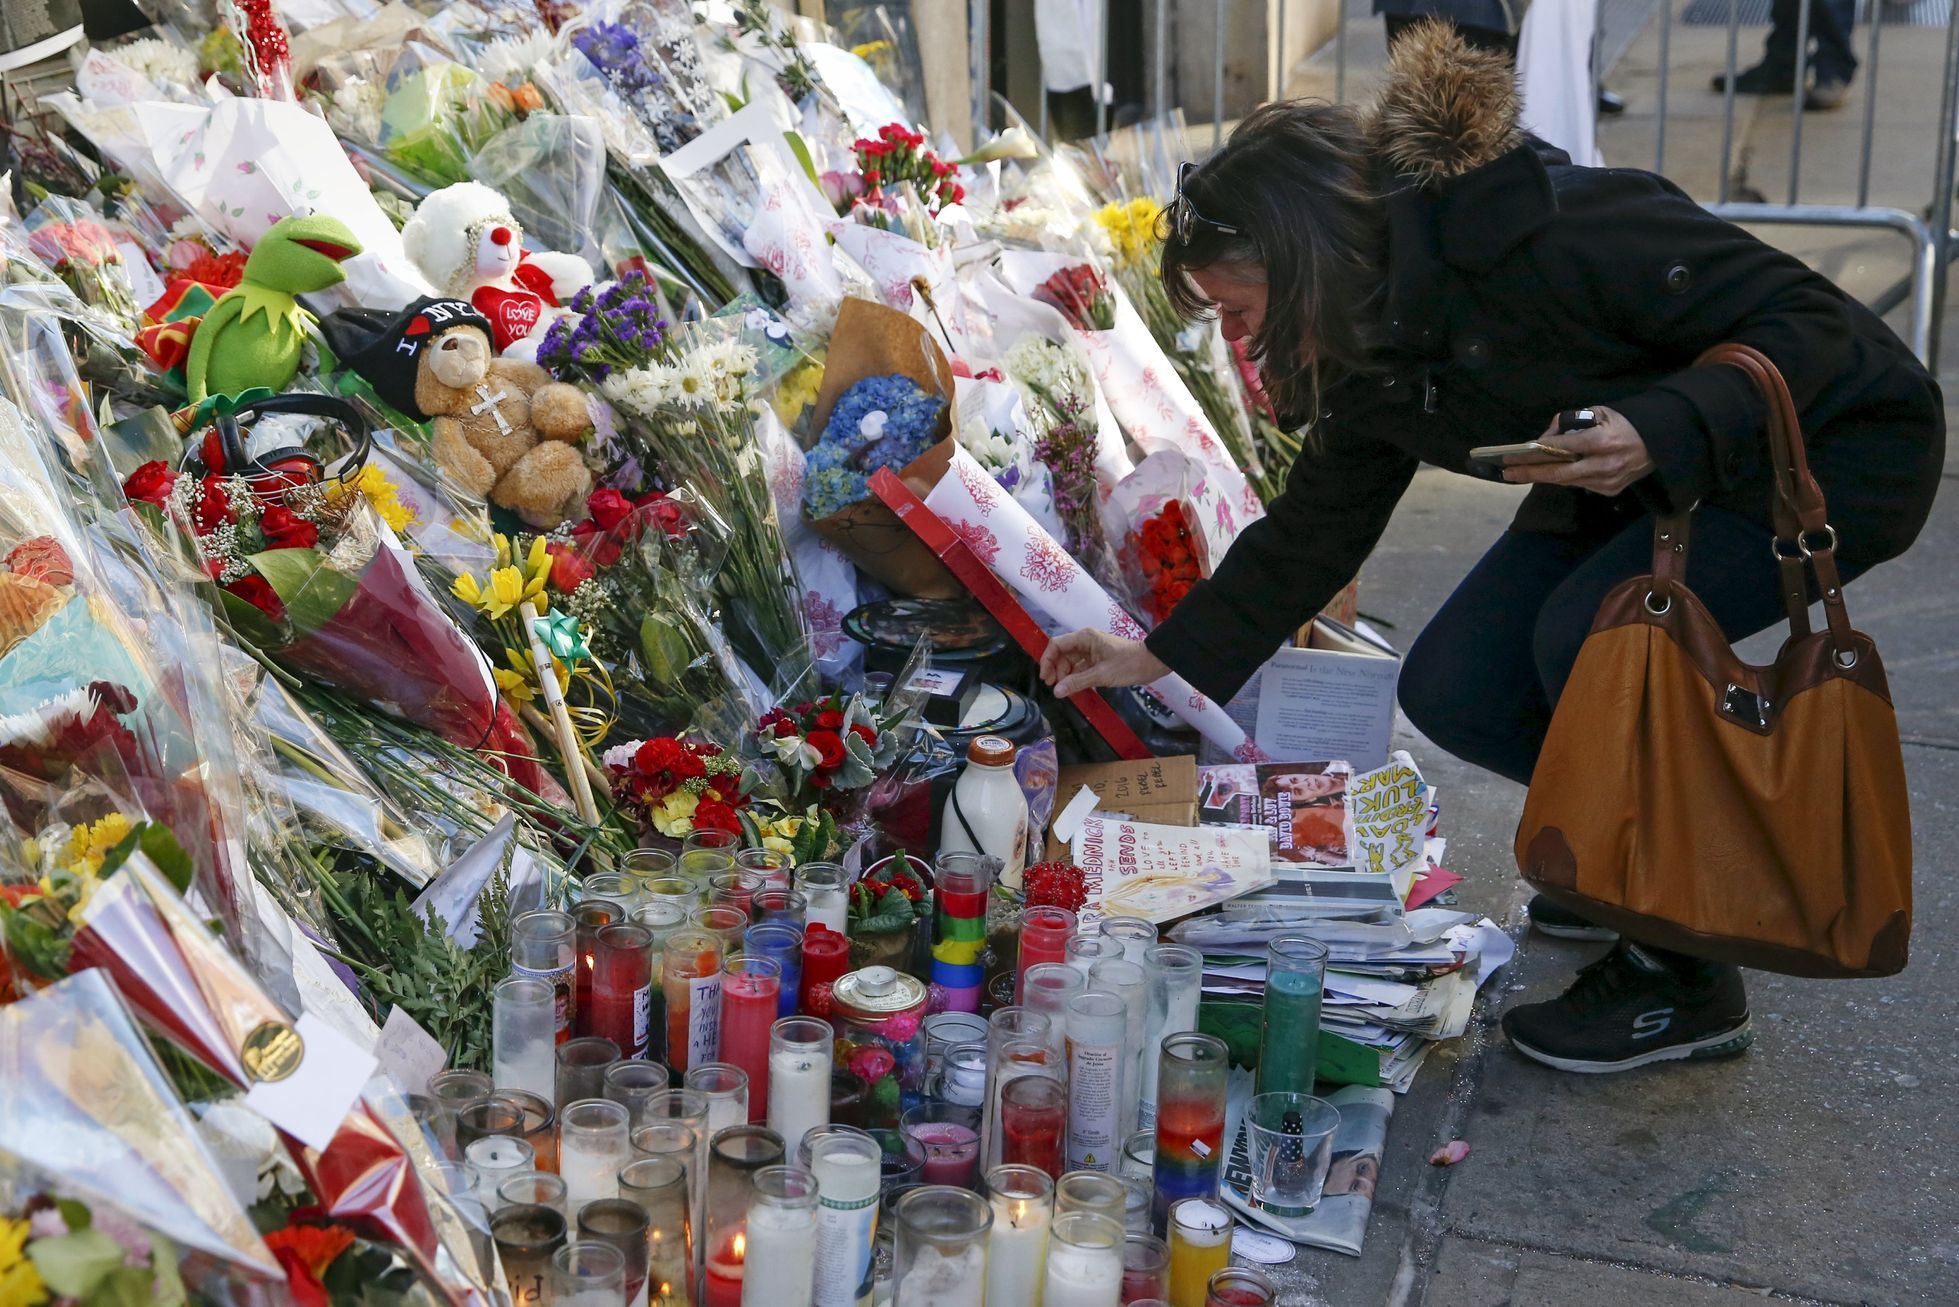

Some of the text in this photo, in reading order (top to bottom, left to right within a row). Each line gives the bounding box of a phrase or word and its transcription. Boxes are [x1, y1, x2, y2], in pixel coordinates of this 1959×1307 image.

[396, 301, 477, 357] I NY
[508, 323, 533, 337] YOU
[1115, 776, 1129, 799] 2016
[1137, 771, 1152, 796] REBEL
[1152, 761, 1168, 788] REBEL
[1277, 791, 1293, 850] DAVID BOWIE
[1082, 816, 1105, 896] MEDNICK
[1118, 824, 1139, 876] SENDS
[1141, 844, 1154, 871] LOVE
[1167, 850, 1178, 871] LEFT
